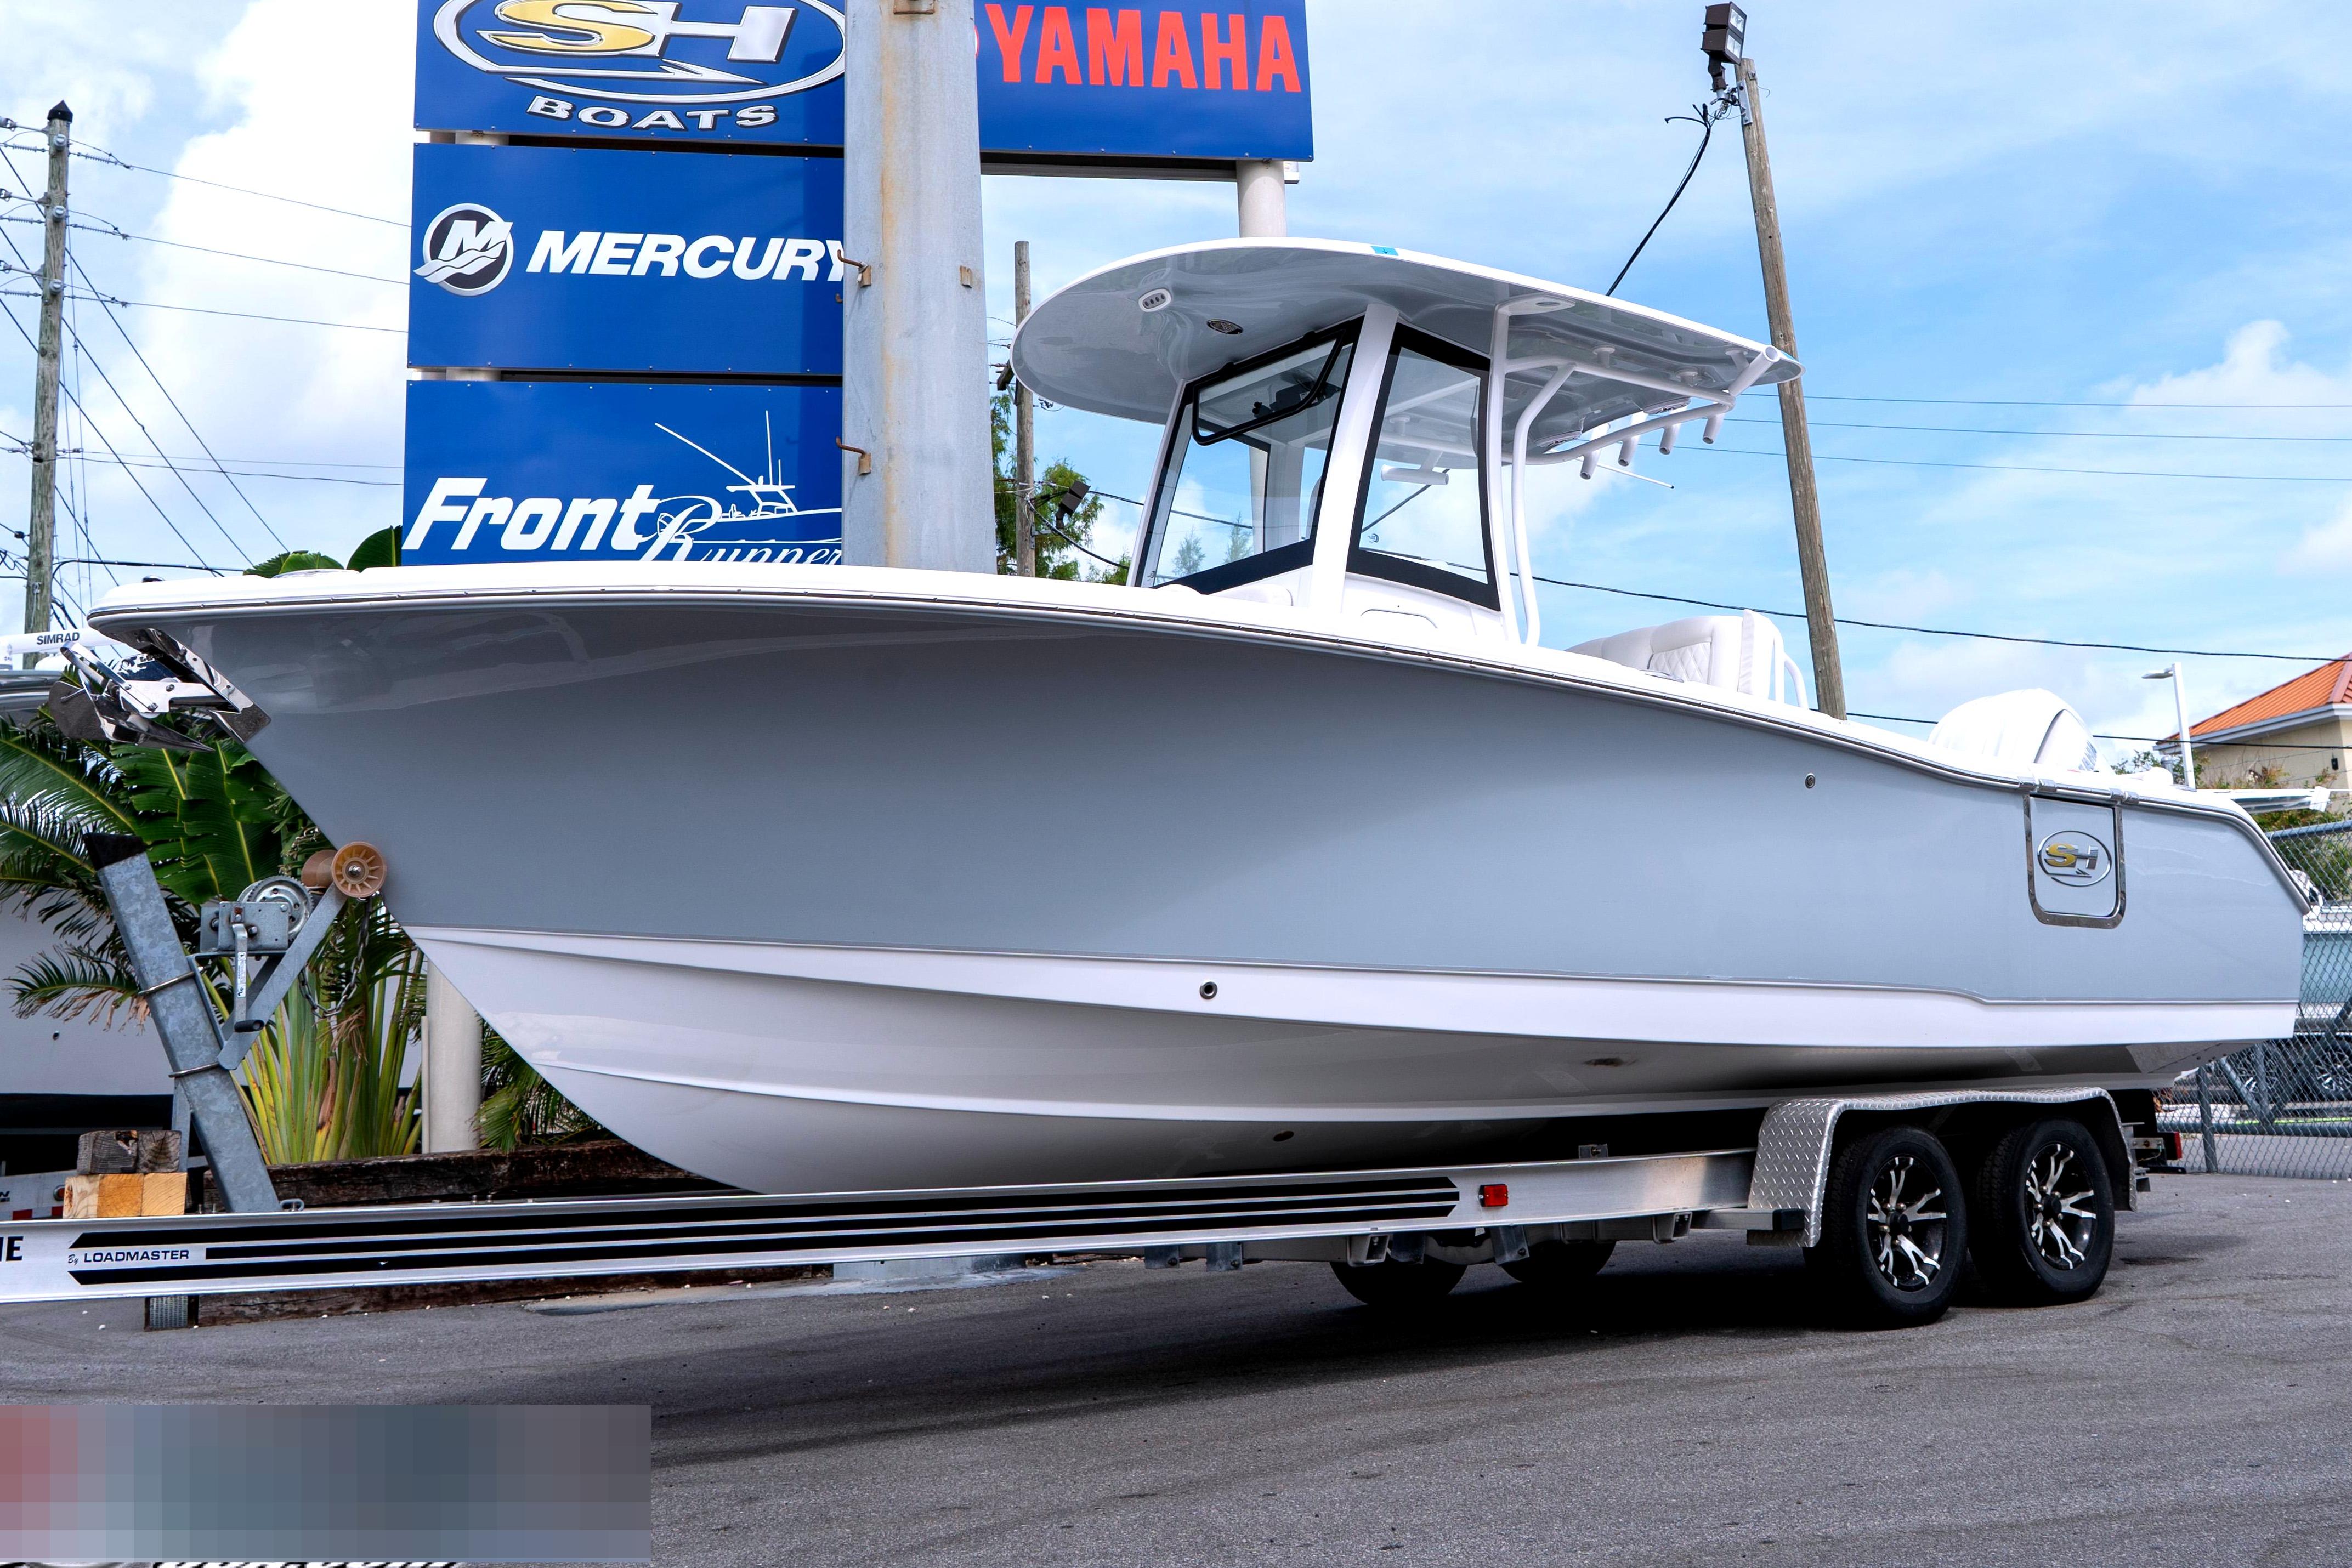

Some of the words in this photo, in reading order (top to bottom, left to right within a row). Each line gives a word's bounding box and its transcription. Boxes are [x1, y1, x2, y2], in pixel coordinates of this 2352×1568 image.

[476, 0, 798, 63] SH
[985, 4, 1302, 93] YAMAHA
[526, 95, 779, 133] BOATS
[402, 478, 660, 550] Front
[36, 632, 80, 645] SIMRAD
[2044, 844, 2099, 870] SH
[0, 1236, 24, 1262] E
[68, 1253, 79, 1265] By
[84, 1249, 190, 1263] LOADMASTER
